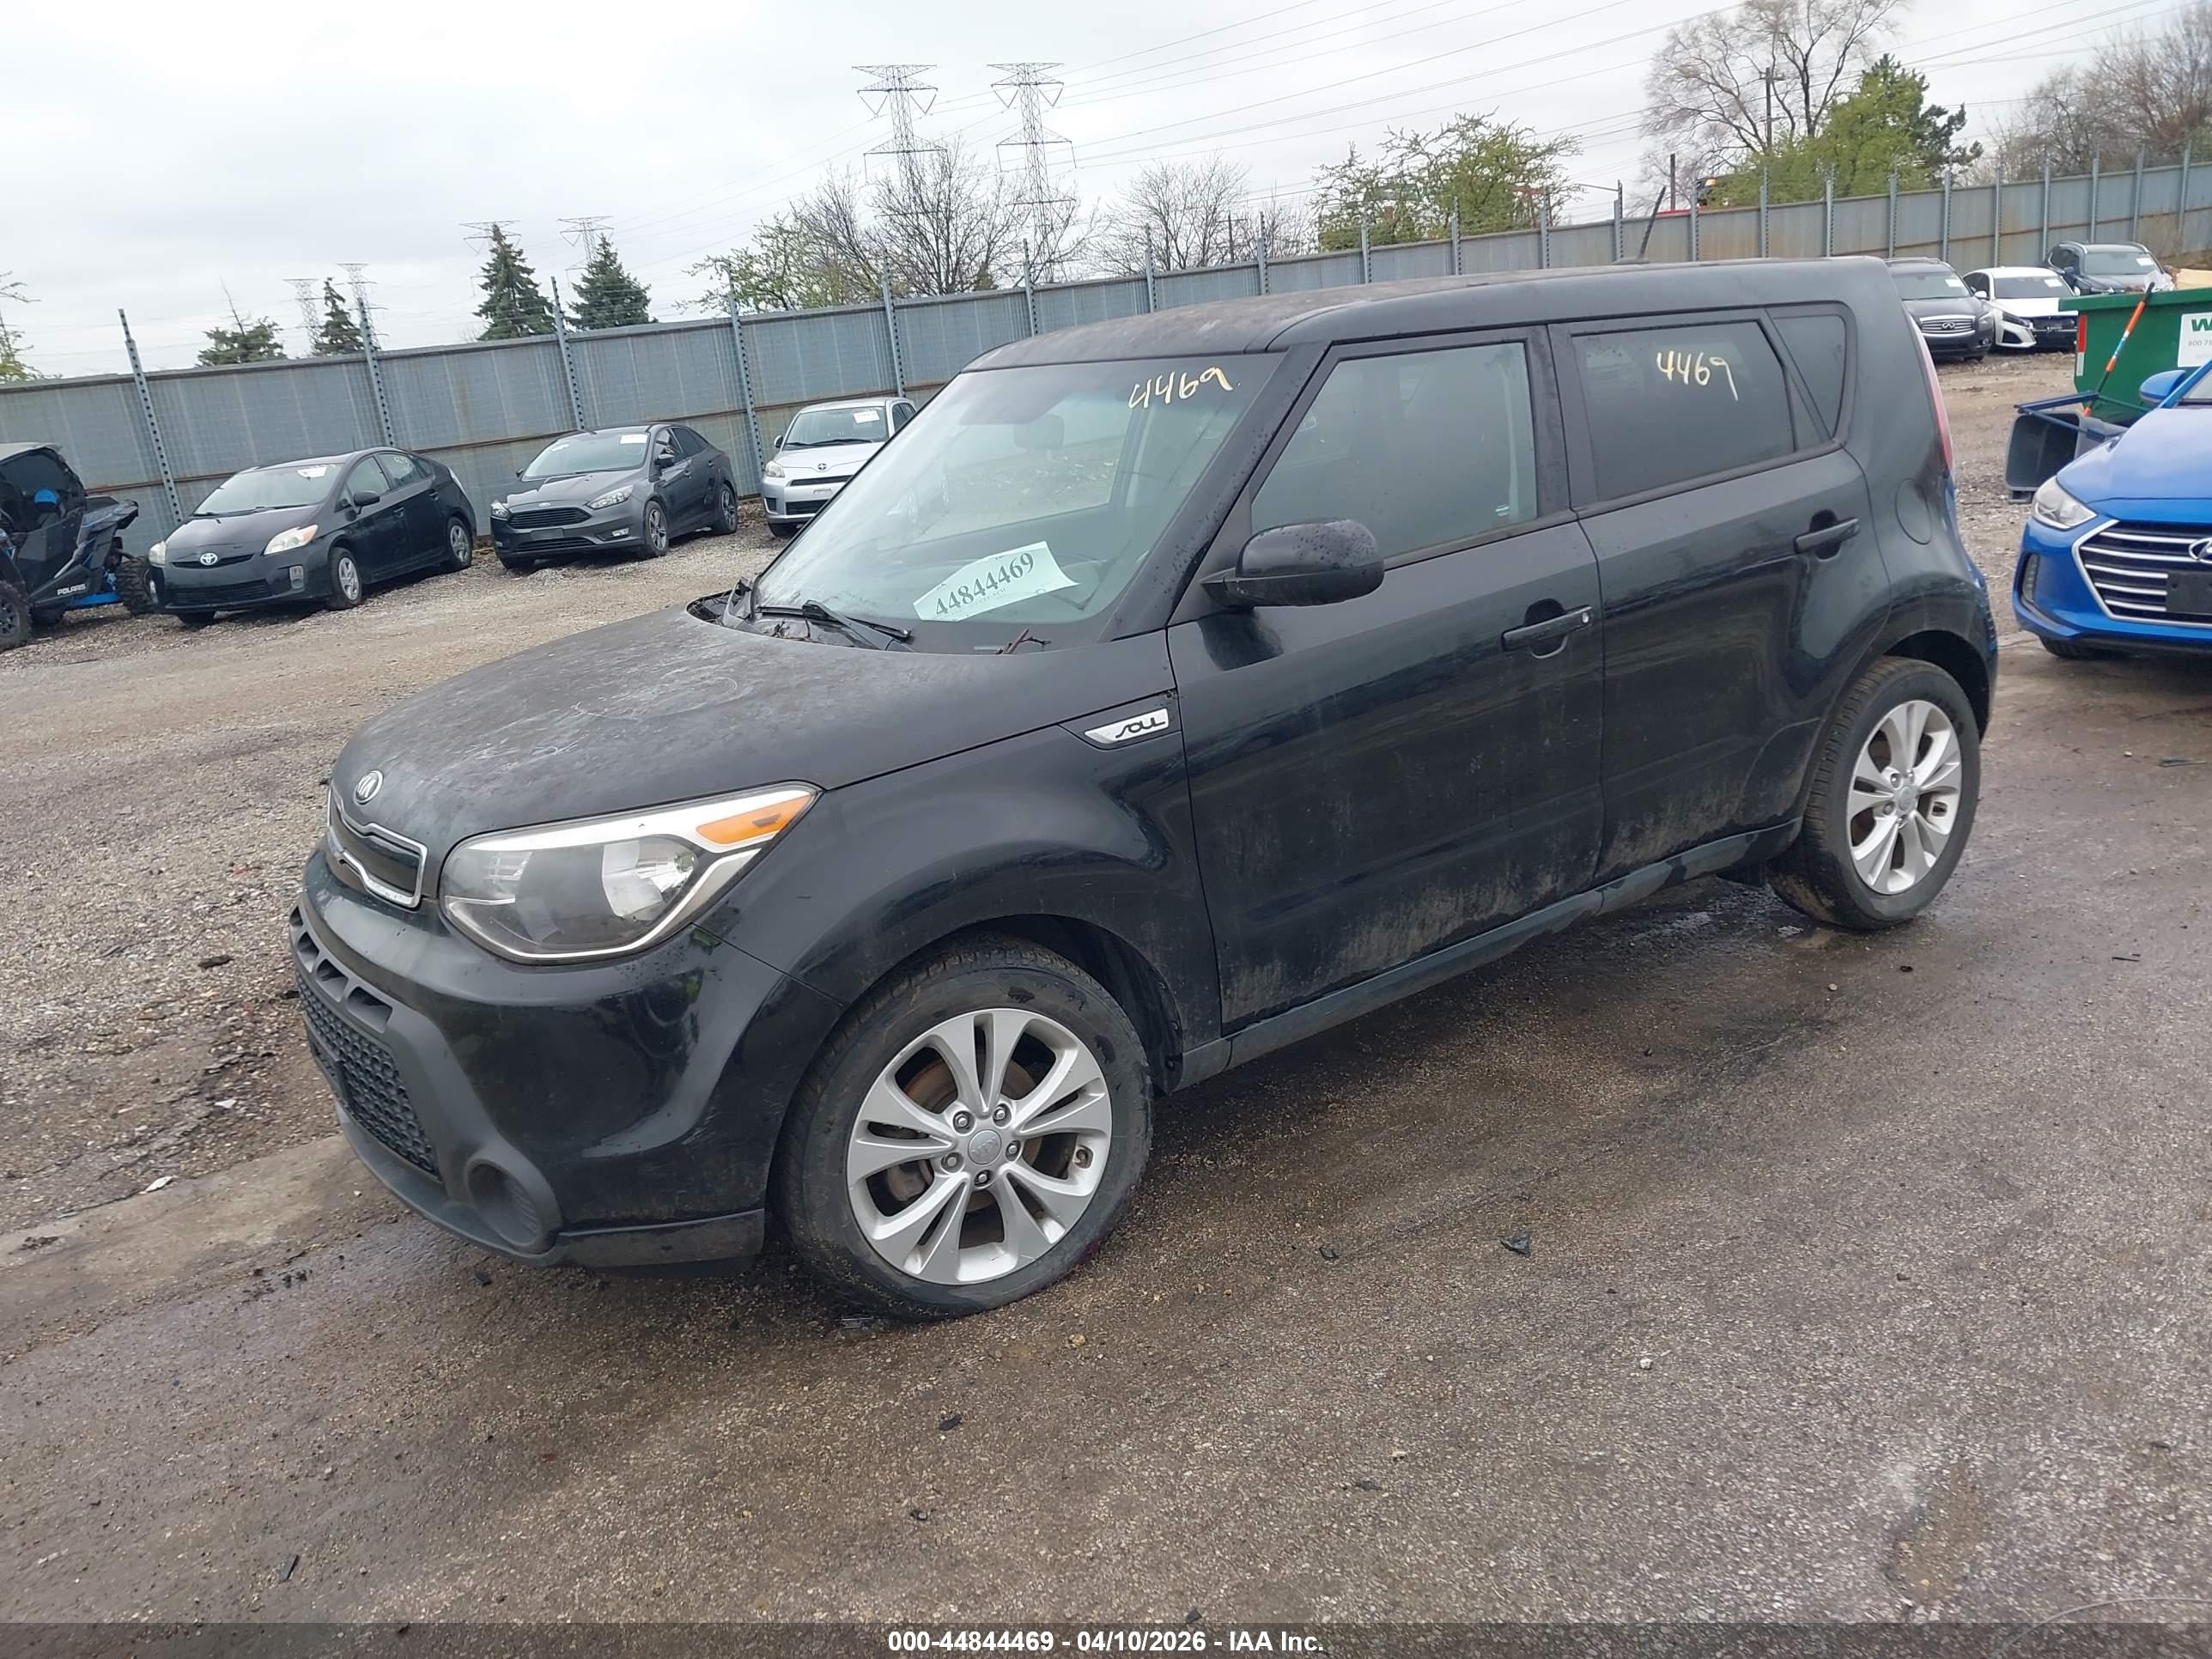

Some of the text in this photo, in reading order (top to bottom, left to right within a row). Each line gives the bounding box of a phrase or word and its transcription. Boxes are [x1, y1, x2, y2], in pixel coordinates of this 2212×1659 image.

[1127, 366, 1233, 409] 4469
[1656, 349, 1739, 401] 4469
[57, 583, 86, 596] POLARIS
[935, 552, 1035, 615] 44844469
